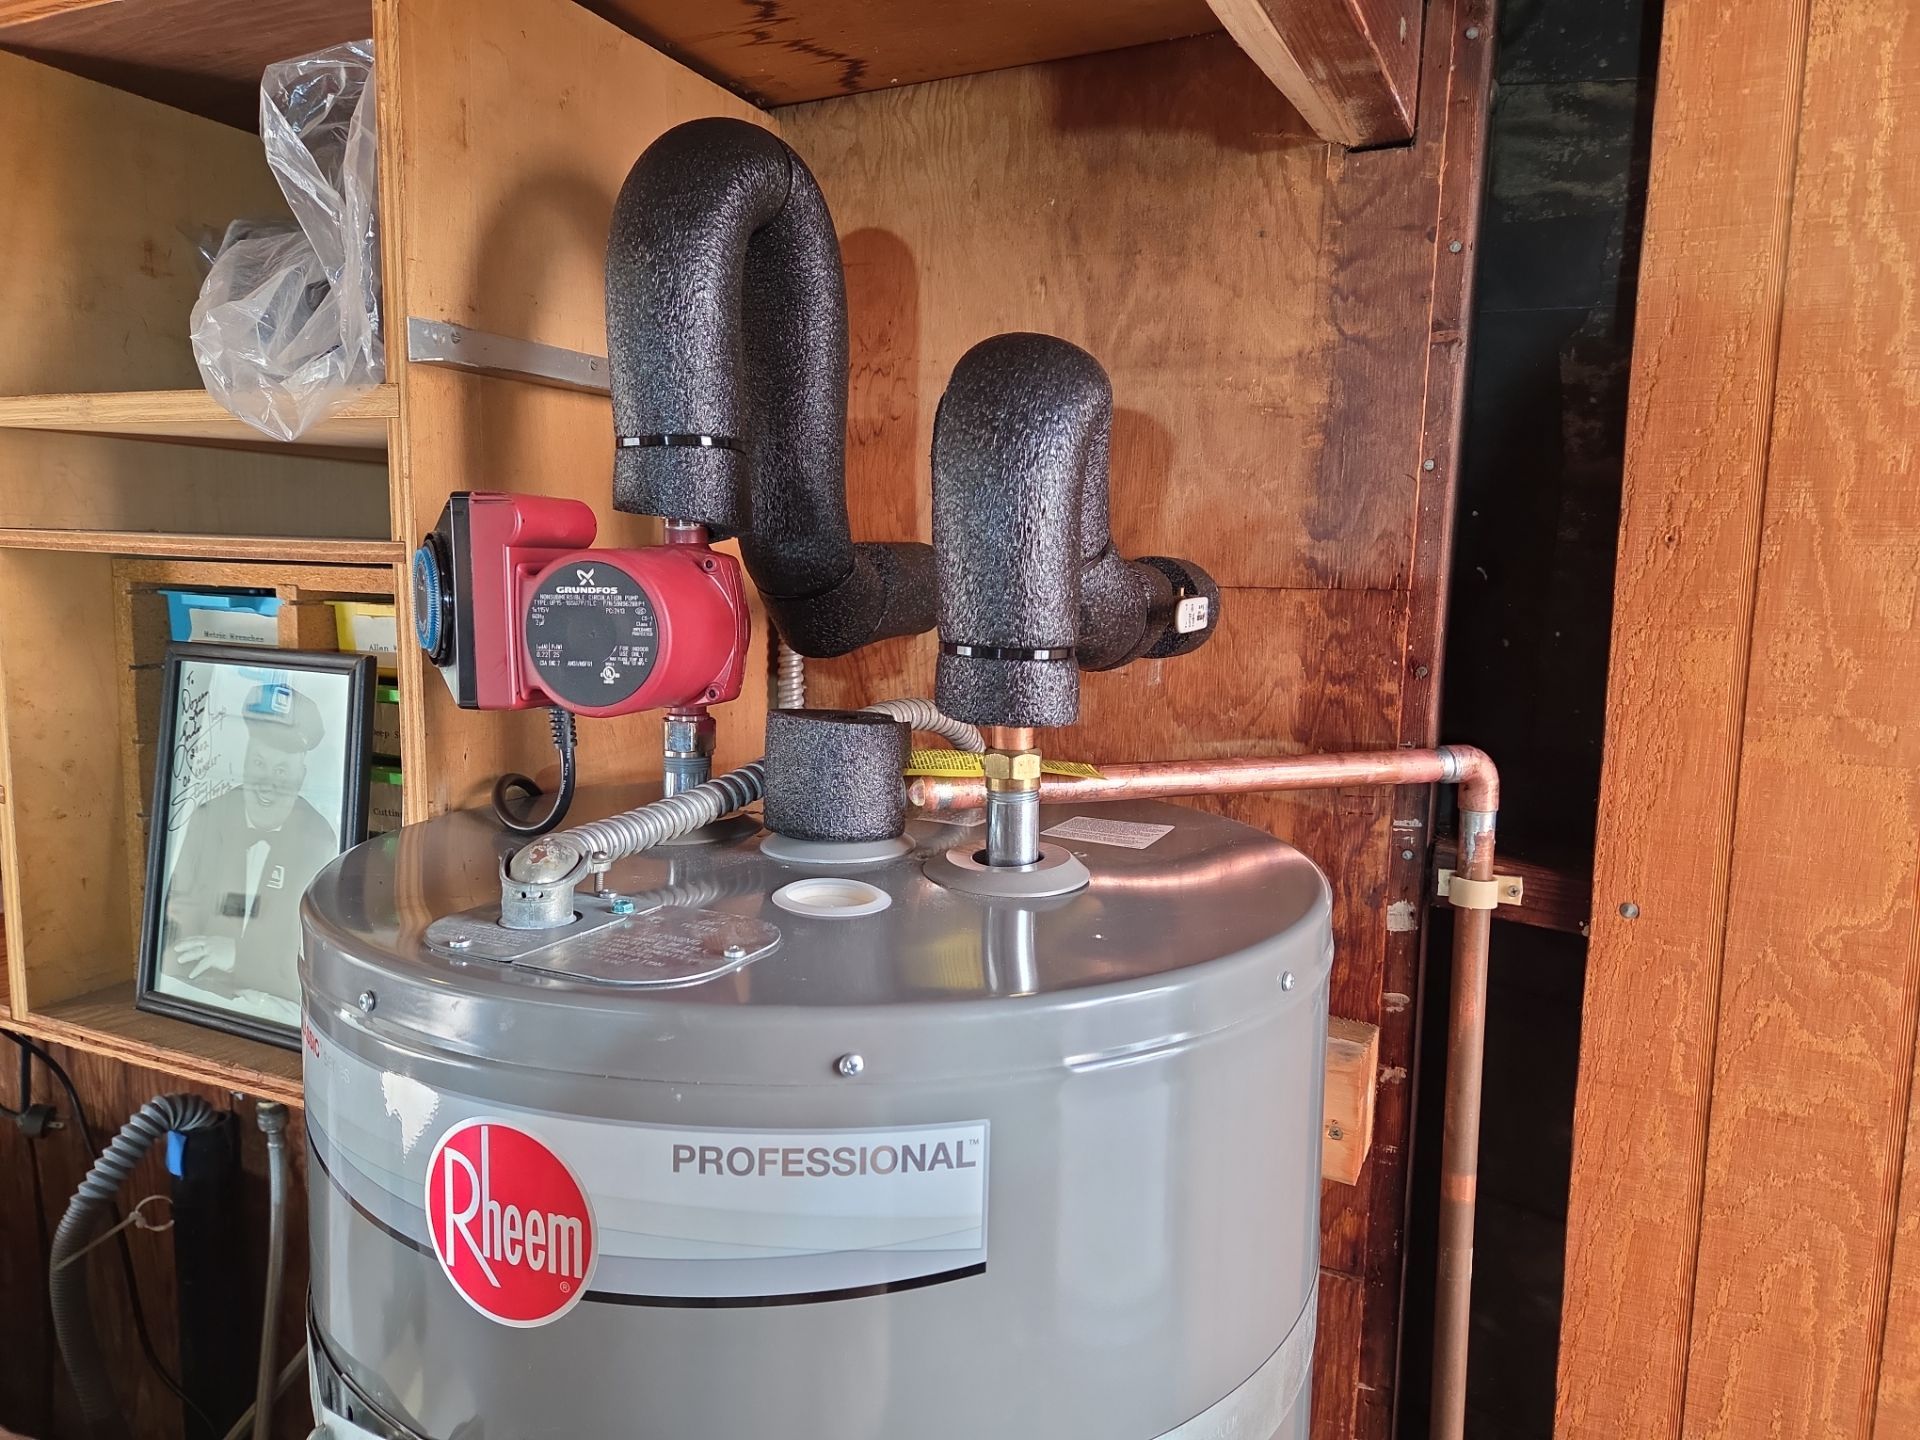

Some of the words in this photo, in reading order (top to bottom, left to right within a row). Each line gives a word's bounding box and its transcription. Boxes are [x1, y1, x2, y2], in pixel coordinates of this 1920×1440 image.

[556, 586, 618, 594] GRUNDFOS
[204, 630, 226, 640] Metric
[229, 634, 264, 642] Wrenches
[373, 807, 402, 818] Cuttin
[673, 1140, 976, 1177] PROFESSIONAL
[443, 1125, 584, 1288] Rheem
